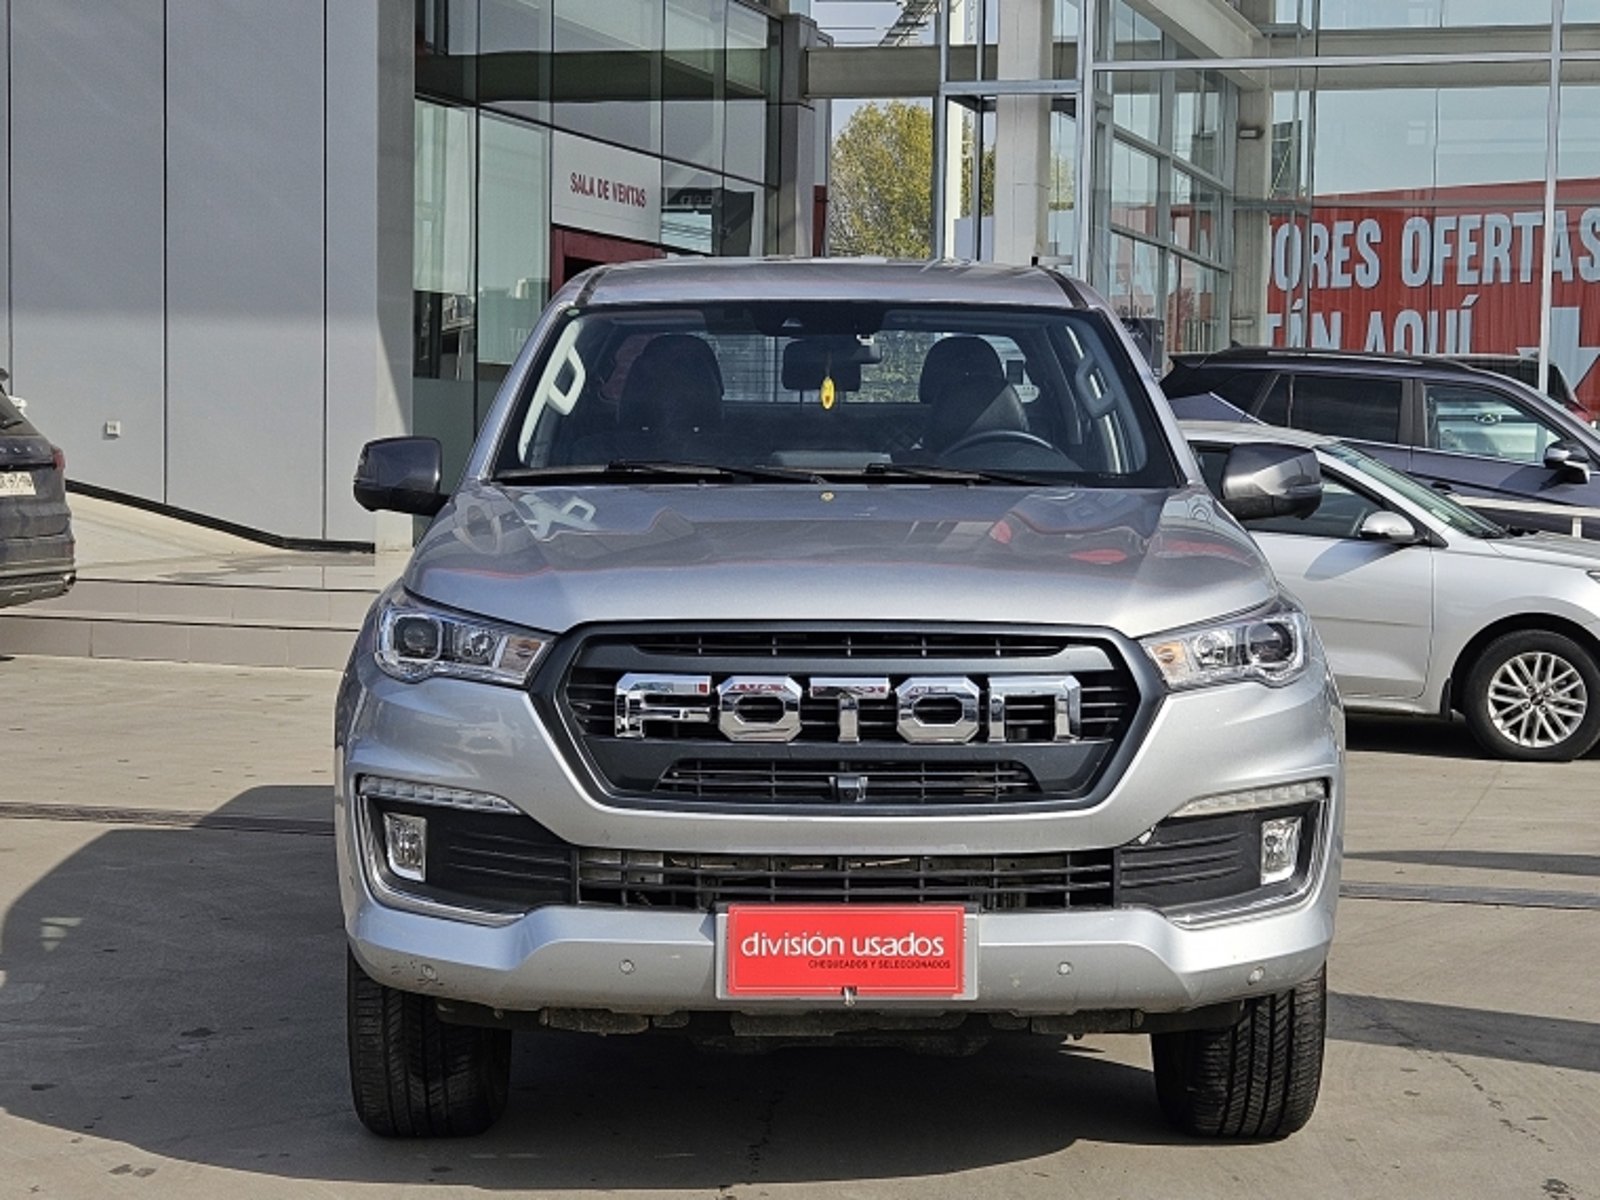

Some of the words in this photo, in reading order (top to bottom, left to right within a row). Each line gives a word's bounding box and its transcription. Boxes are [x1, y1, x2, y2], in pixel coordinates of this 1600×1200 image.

[570, 171, 595, 196] SALA
[597, 178, 609, 200] DE
[612, 182, 646, 208] VENTAS
[1267, 218, 1382, 291] ORES
[1401, 207, 1600, 287] OFERTAS
[614, 672, 1082, 743] FOTON
[740, 931, 845, 957] división
[852, 932, 945, 957] usados
[807, 960, 868, 969] CHEQUEADOS
[870, 960, 876, 968] Y
[878, 960, 951, 969] SELECCIONADOS
